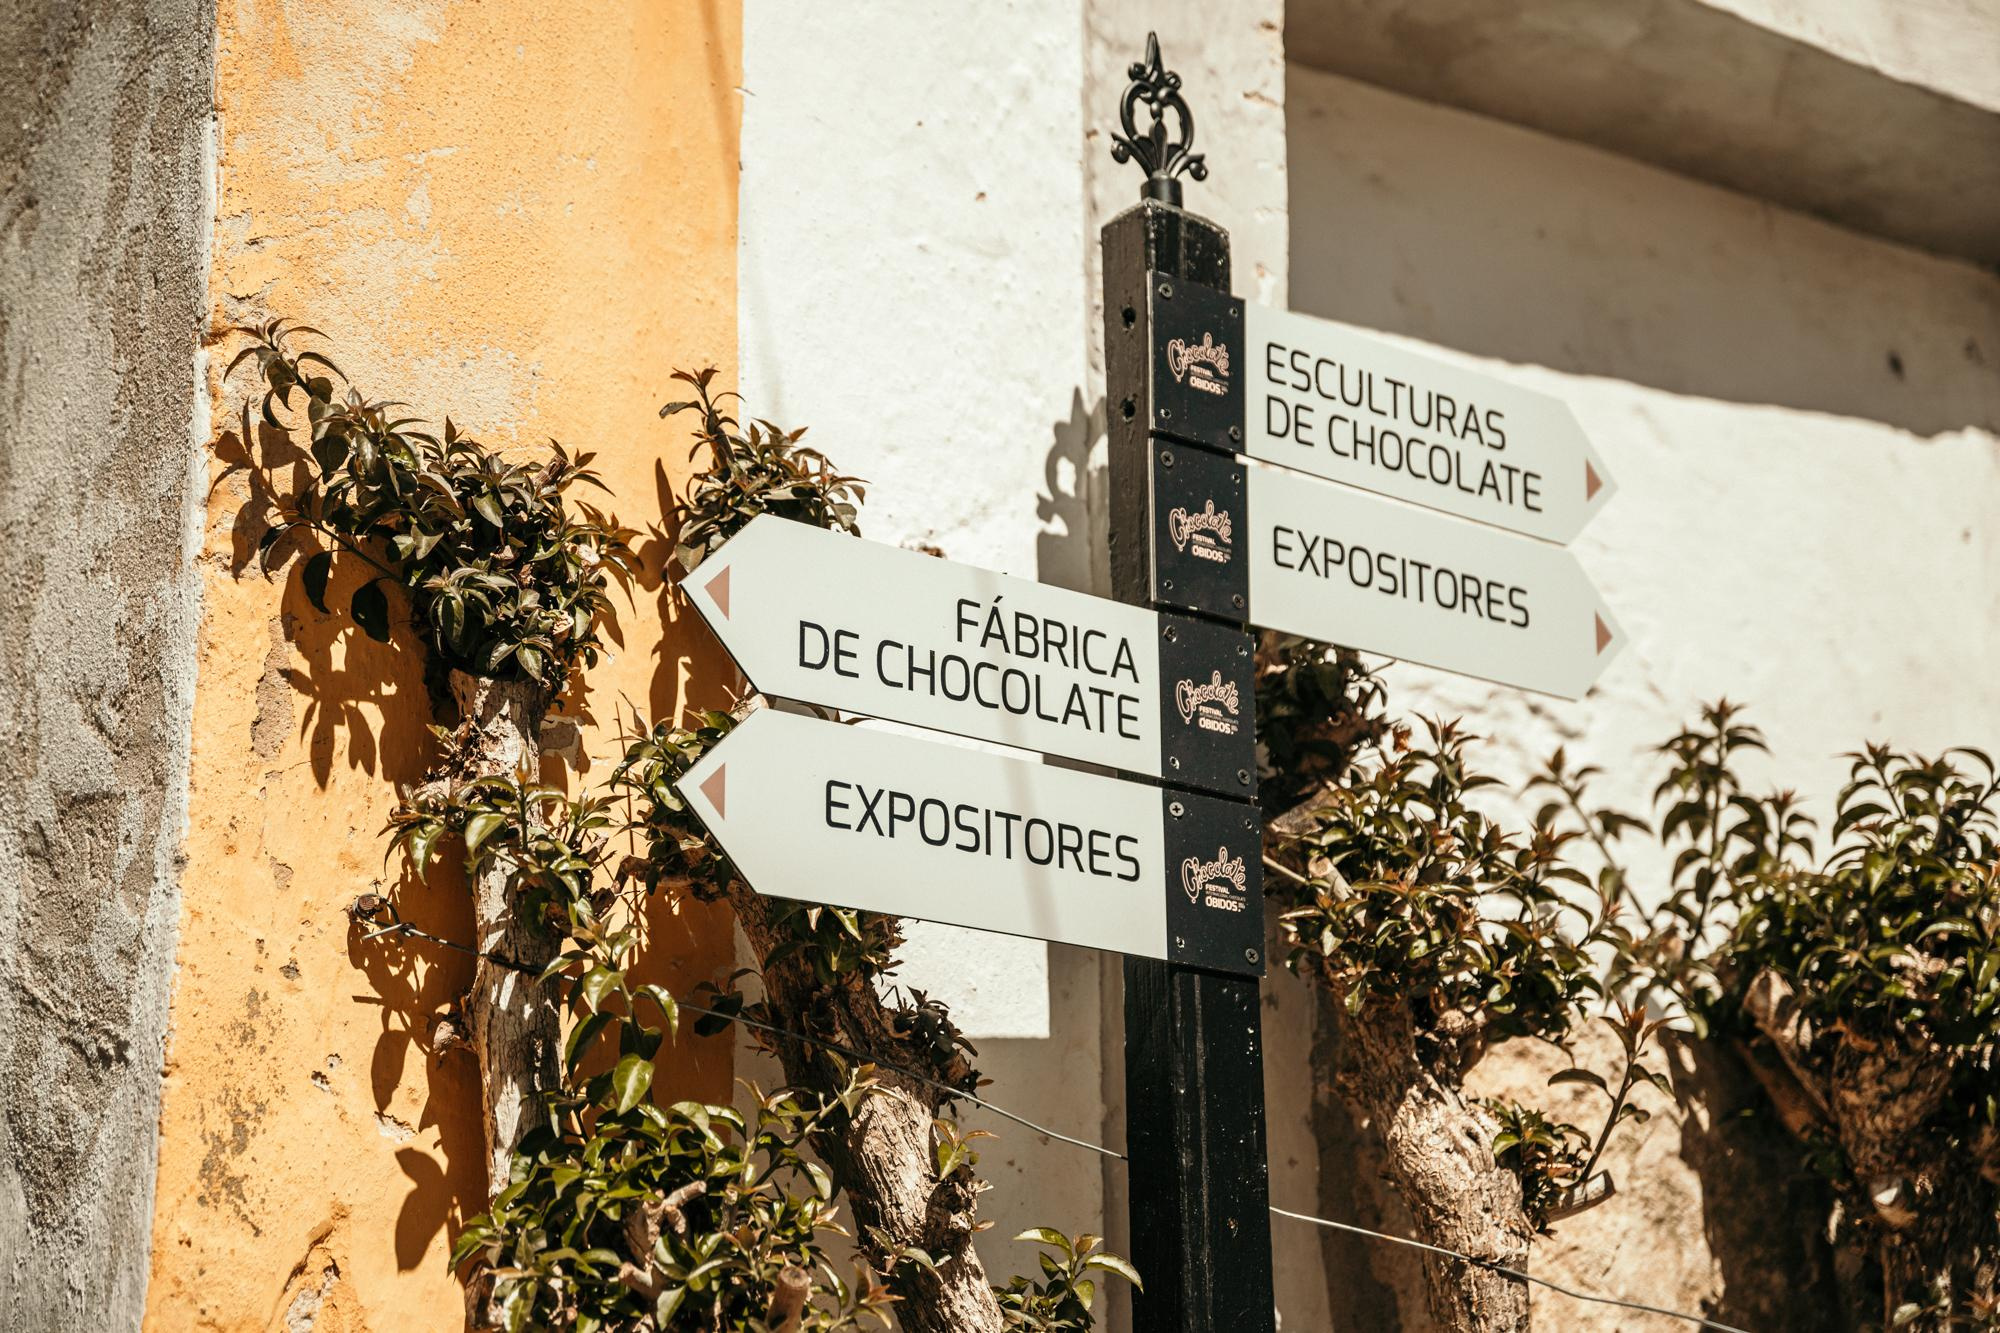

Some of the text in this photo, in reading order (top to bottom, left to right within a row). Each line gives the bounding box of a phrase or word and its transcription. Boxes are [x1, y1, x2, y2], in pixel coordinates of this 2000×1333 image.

[1266, 342, 1507, 451] ESCULTURAS
[1266, 395, 1544, 513] DE CHOCOLATE
[1169, 499, 1232, 552] Chocolate
[1272, 525, 1530, 629] EXPOSITORES
[799, 620, 1142, 741] DE CHOCOLATE
[956, 595, 1141, 684] FÁBRICA
[1176, 670, 1239, 725] Chocolate
[825, 779, 1141, 883] EXPOSITORES
[1182, 846, 1246, 905] Chocolate
